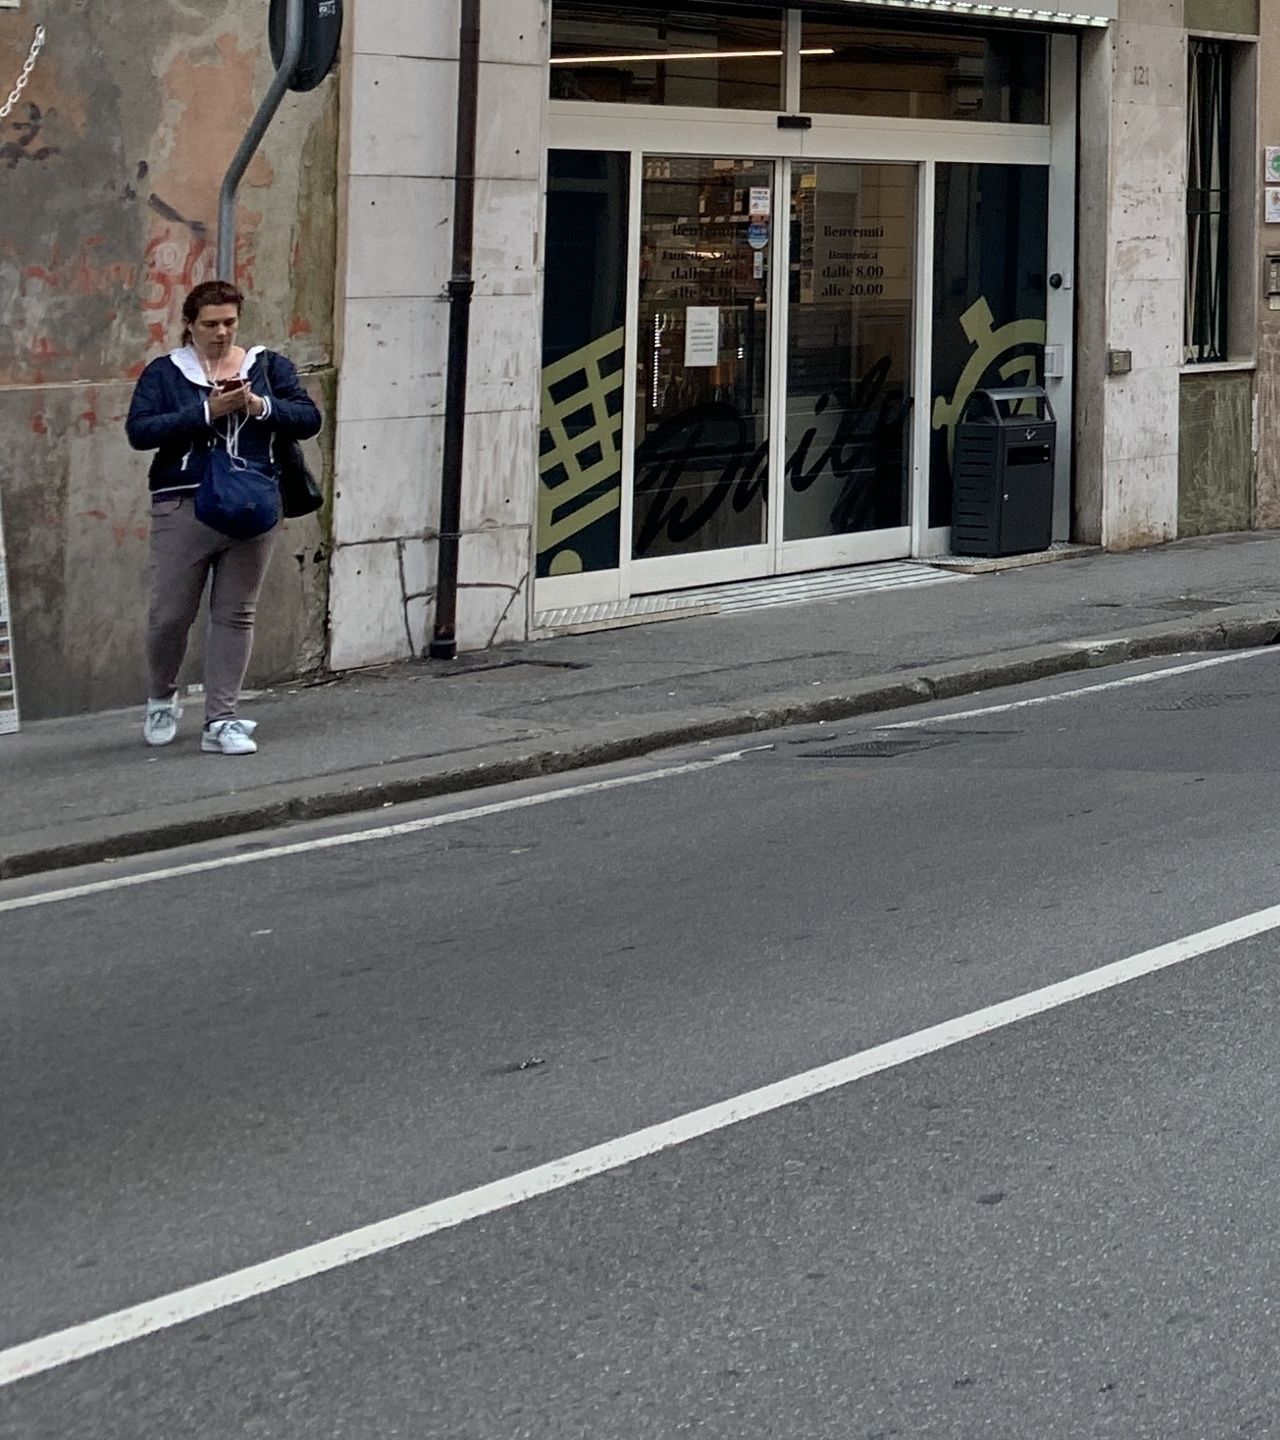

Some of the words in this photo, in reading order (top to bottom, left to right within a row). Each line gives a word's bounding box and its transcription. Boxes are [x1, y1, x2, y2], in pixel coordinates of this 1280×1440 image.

[823, 225, 884, 237] Benvenuti
[822, 265, 853, 278] dalle
[856, 265, 884, 278] 8.00
[821, 284, 845, 296] alle
[849, 284, 884, 296] 20.00
